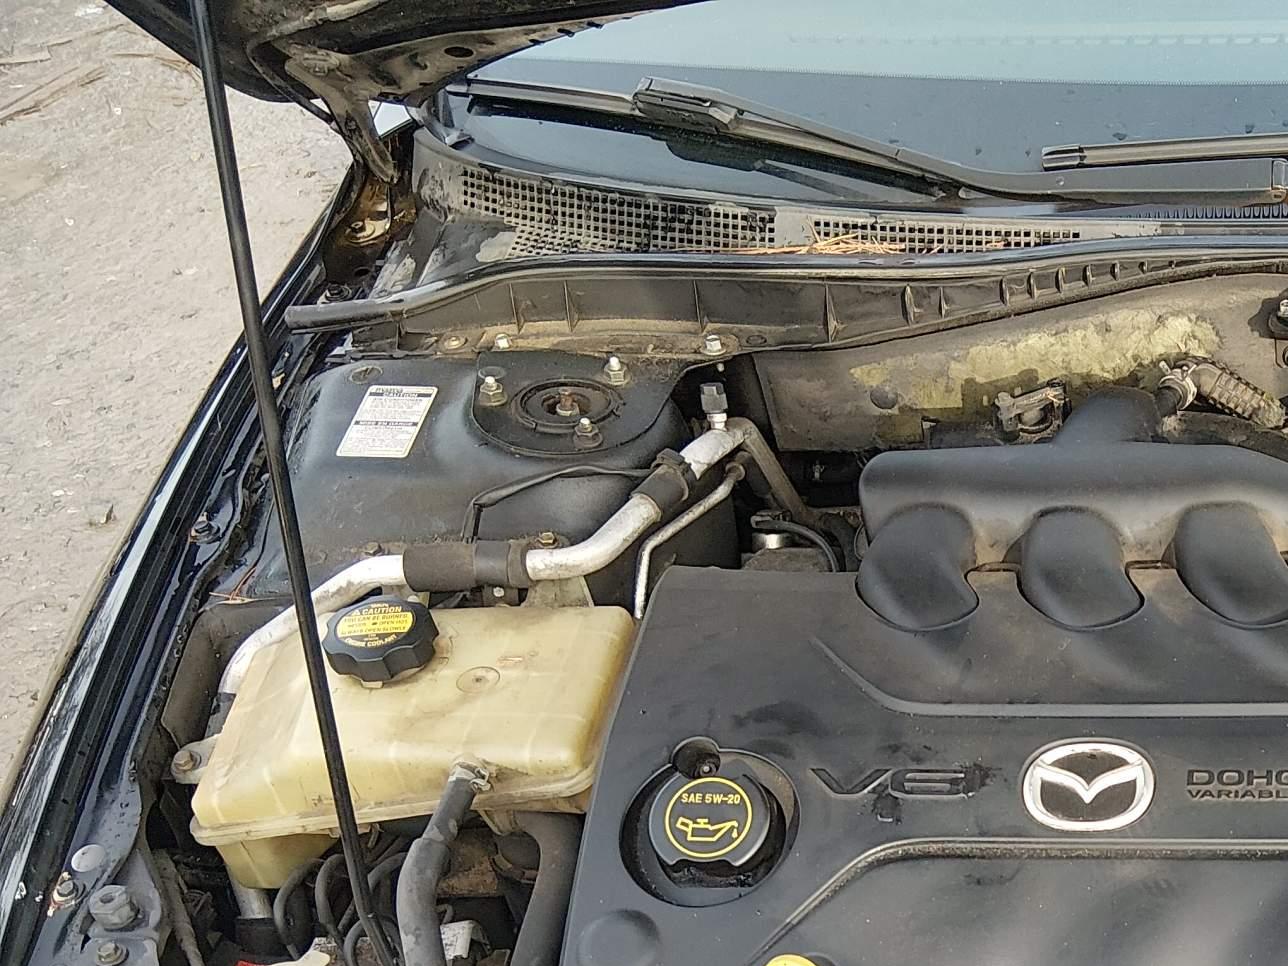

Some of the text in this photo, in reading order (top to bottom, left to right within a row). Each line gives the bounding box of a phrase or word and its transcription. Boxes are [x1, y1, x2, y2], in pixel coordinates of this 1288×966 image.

[362, 606, 402, 616] CAUTION
[809, 768, 968, 799] V6
[681, 792, 741, 804] SAE 5W-20
